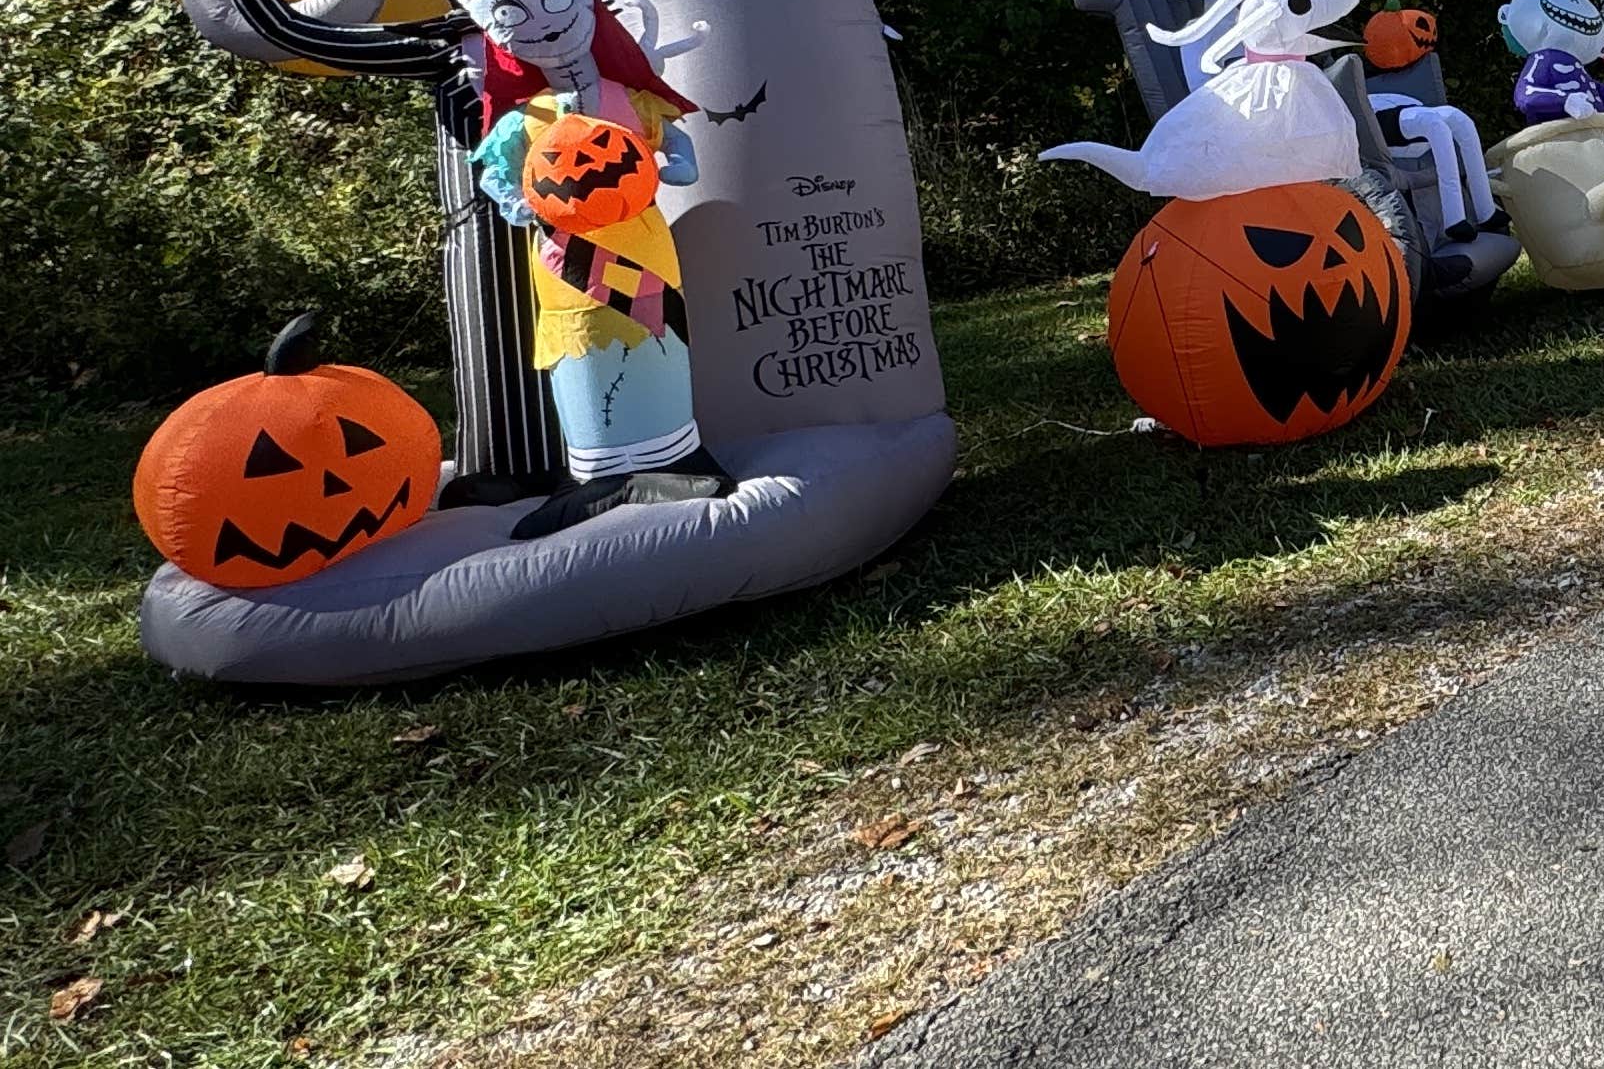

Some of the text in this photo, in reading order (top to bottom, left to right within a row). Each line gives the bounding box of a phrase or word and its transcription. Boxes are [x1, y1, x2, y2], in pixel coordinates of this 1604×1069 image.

[755, 206, 886, 247] TIM BURTON'S
[801, 241, 855, 271] THE
[732, 261, 914, 332] NIGHTMARE
[786, 302, 898, 354] BEFORE
[752, 331, 921, 398] CHRISTMAS
